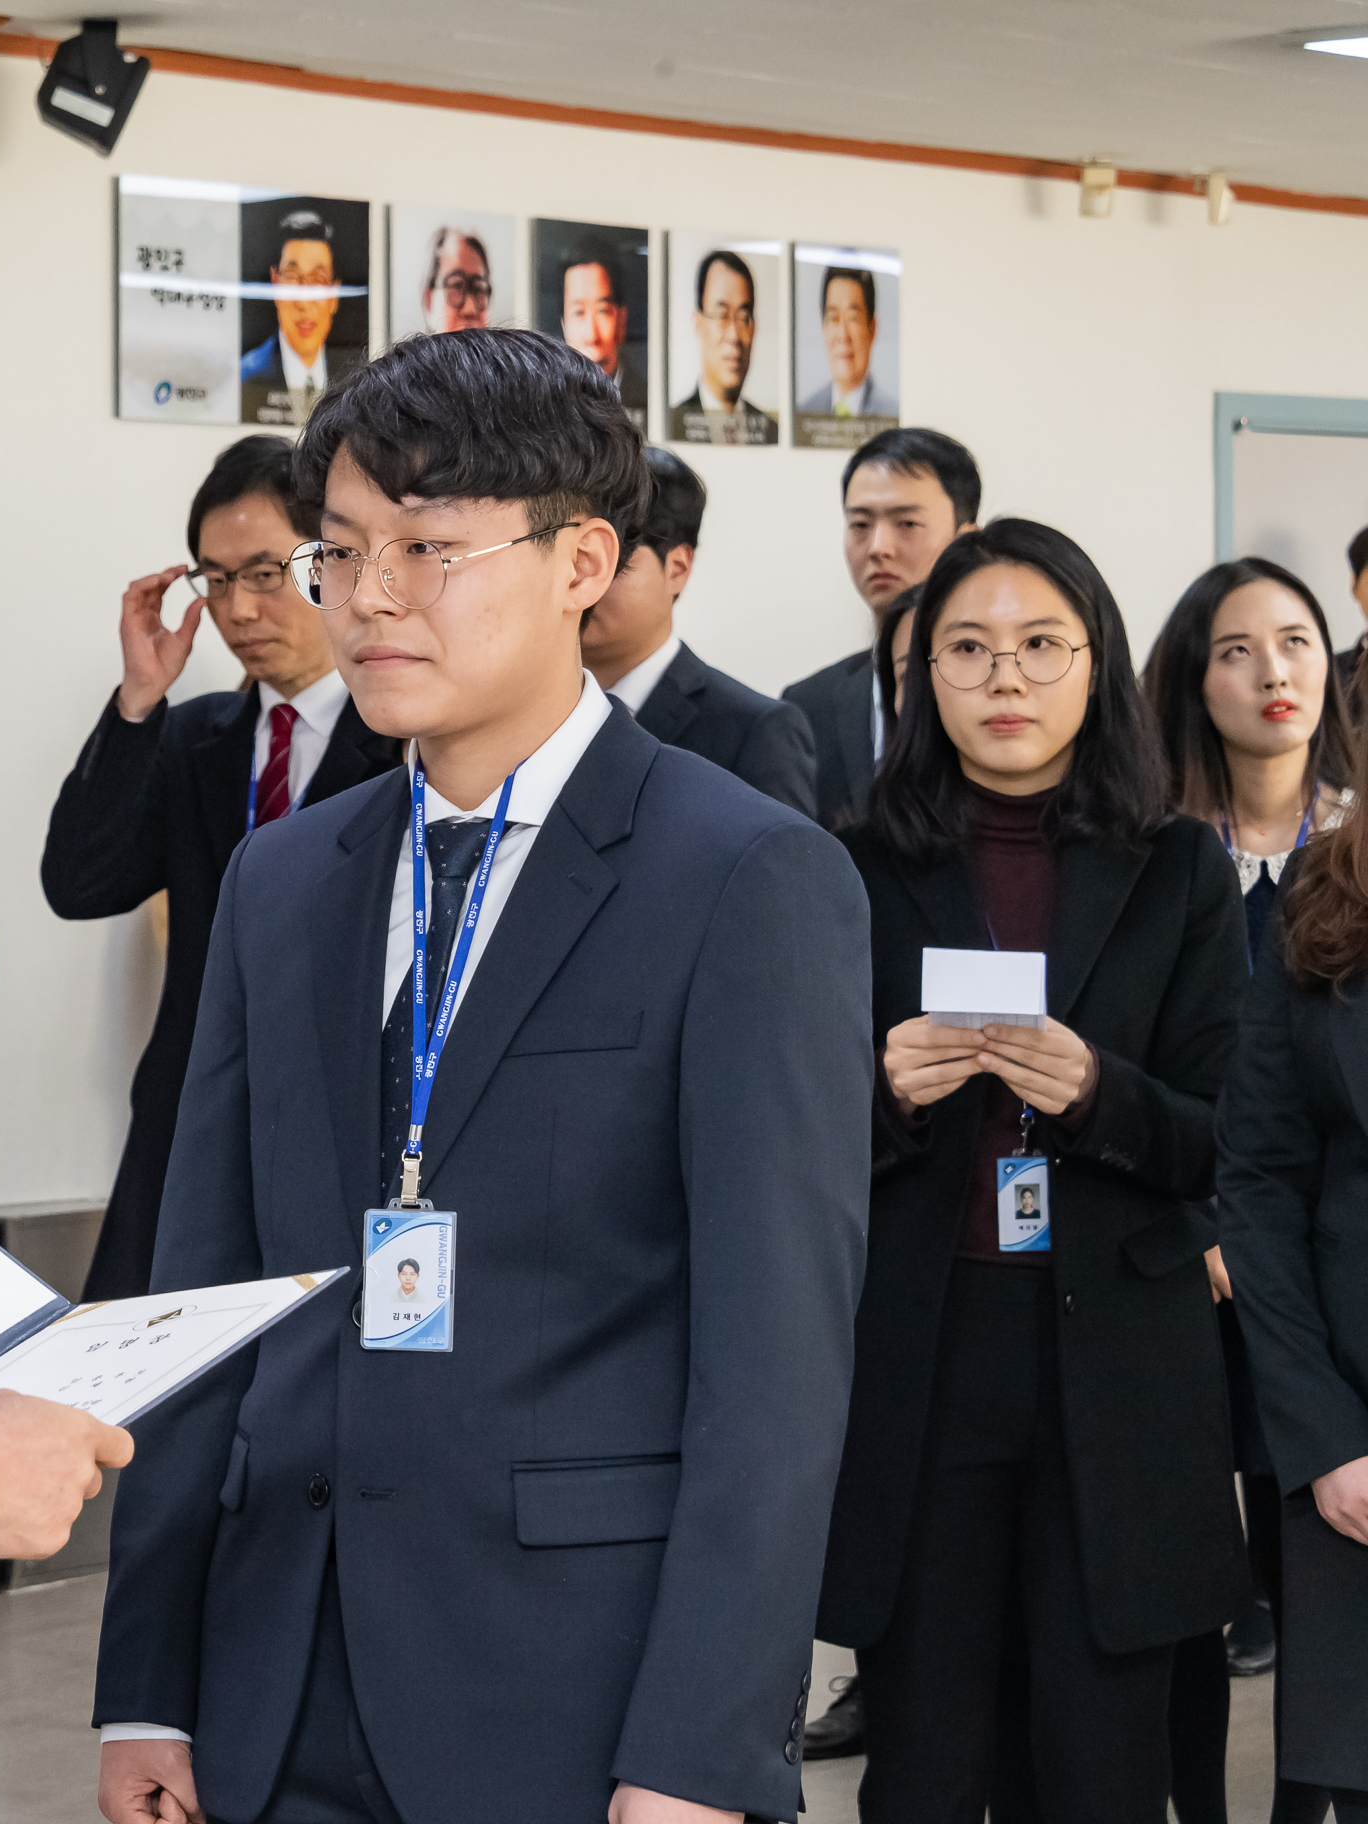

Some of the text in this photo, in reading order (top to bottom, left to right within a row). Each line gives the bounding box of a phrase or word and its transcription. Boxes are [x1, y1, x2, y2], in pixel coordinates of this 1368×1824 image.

[478, 831, 499, 887] GWANGJIN-GU
[466, 902, 479, 928] 광진구
[436, 980, 458, 1037] GWANGJIN-GU
[424, 1052, 437, 1078] 광진구
[437, 1225, 448, 1299] GWANGJIN-GU
